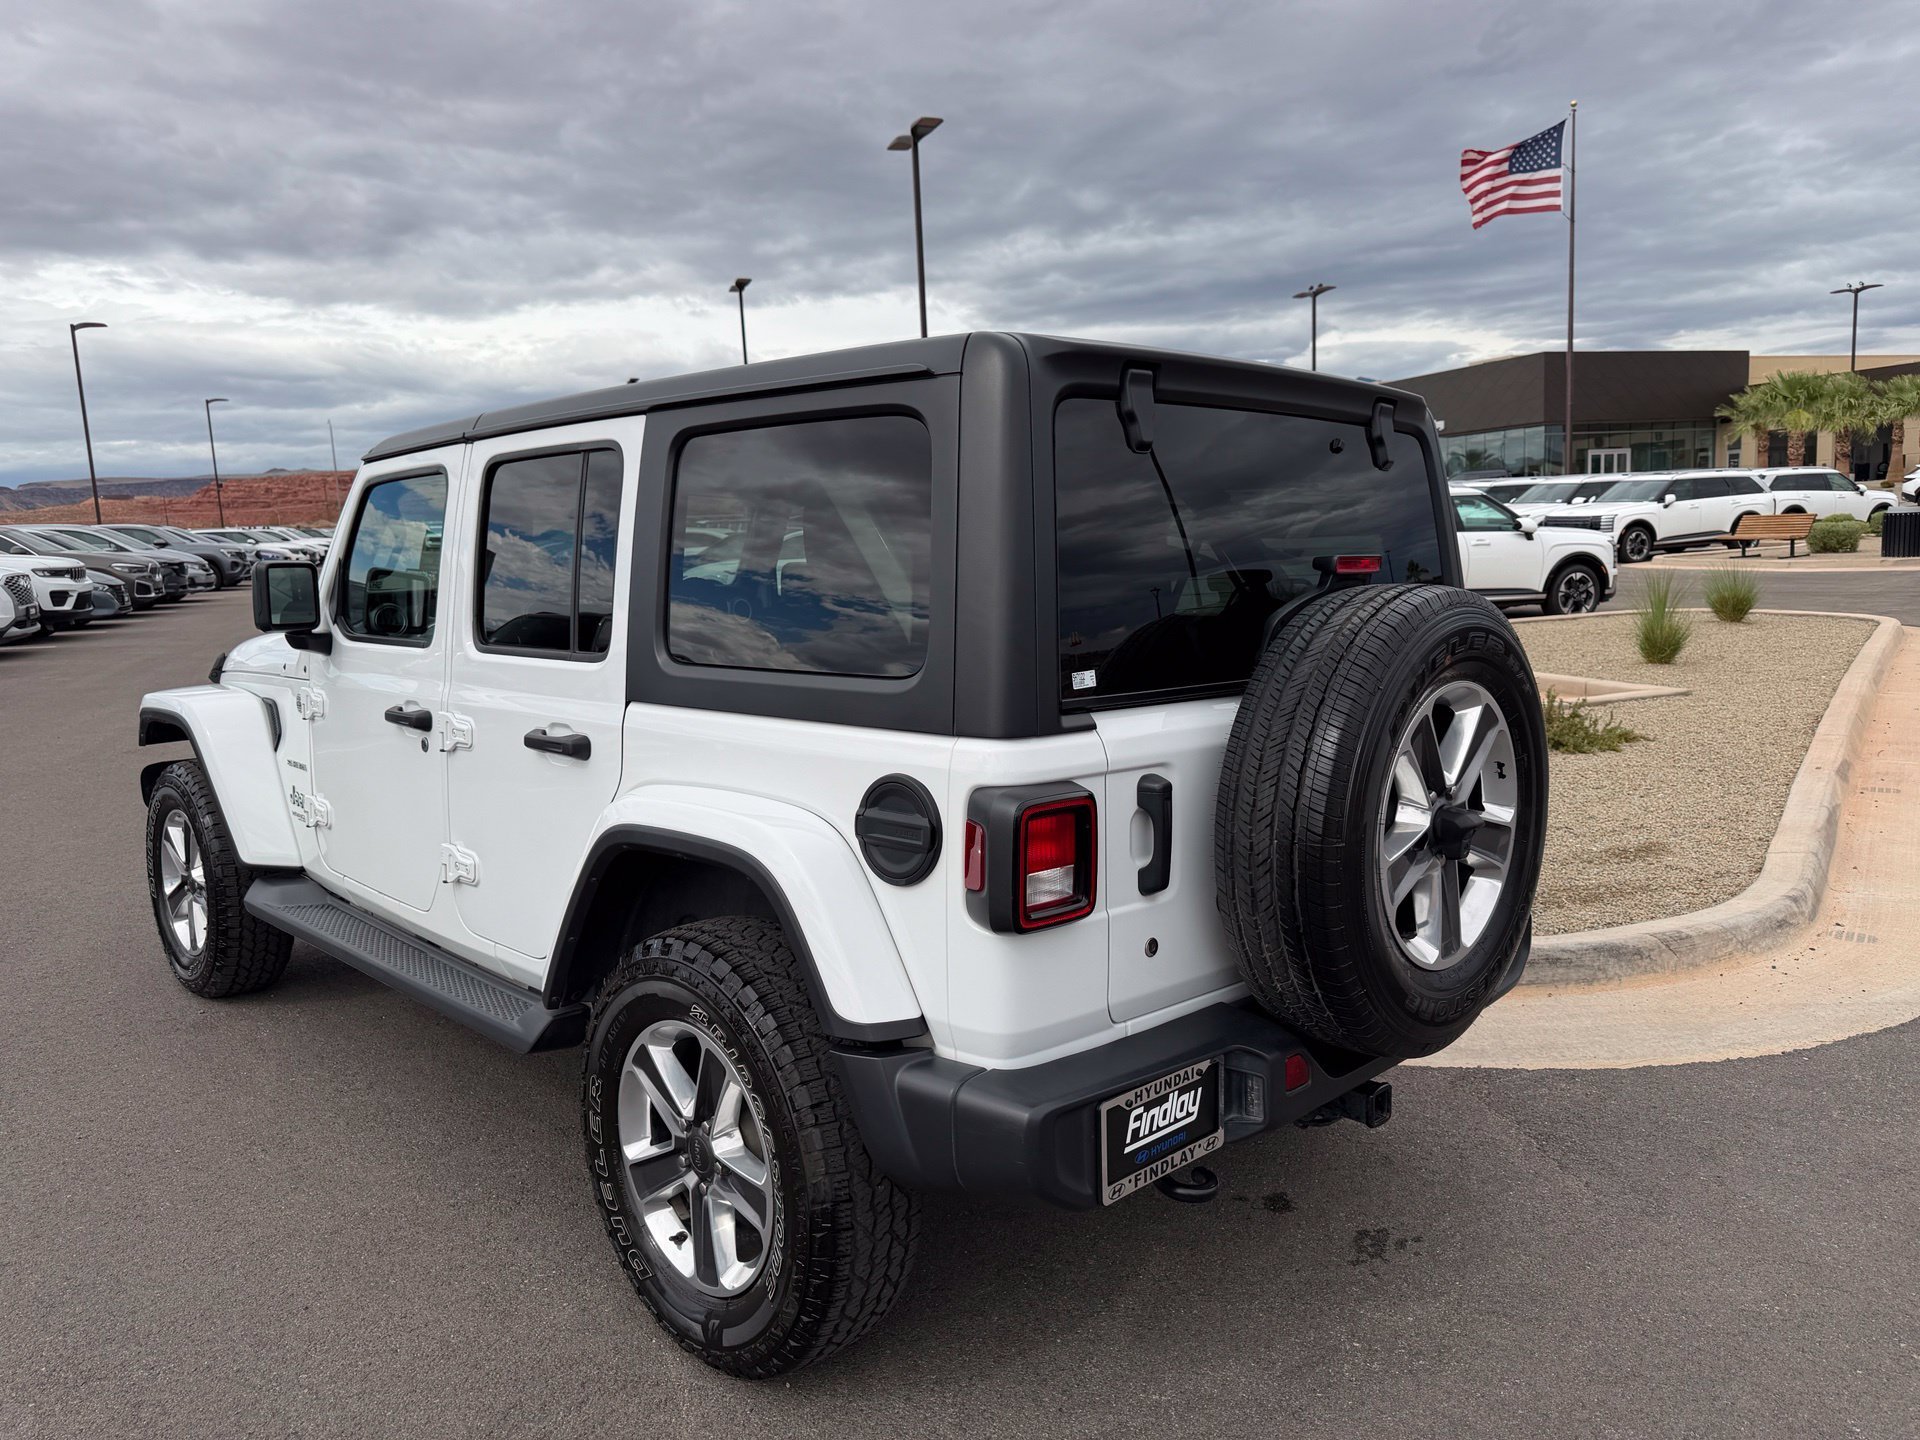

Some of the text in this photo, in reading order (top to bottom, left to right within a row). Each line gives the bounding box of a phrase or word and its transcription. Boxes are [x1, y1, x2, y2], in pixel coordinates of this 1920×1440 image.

[290, 785, 305, 809] Jee
[1134, 1067, 1195, 1105] HYUNDAI
[1125, 1086, 1203, 1151] Findlay
[689, 1004, 785, 1300] BRIDGESTONE
[1150, 1131, 1187, 1156] HYUNDAI
[589, 1073, 656, 1280] DUELER
[1134, 1146, 1197, 1189] FINDLAY
